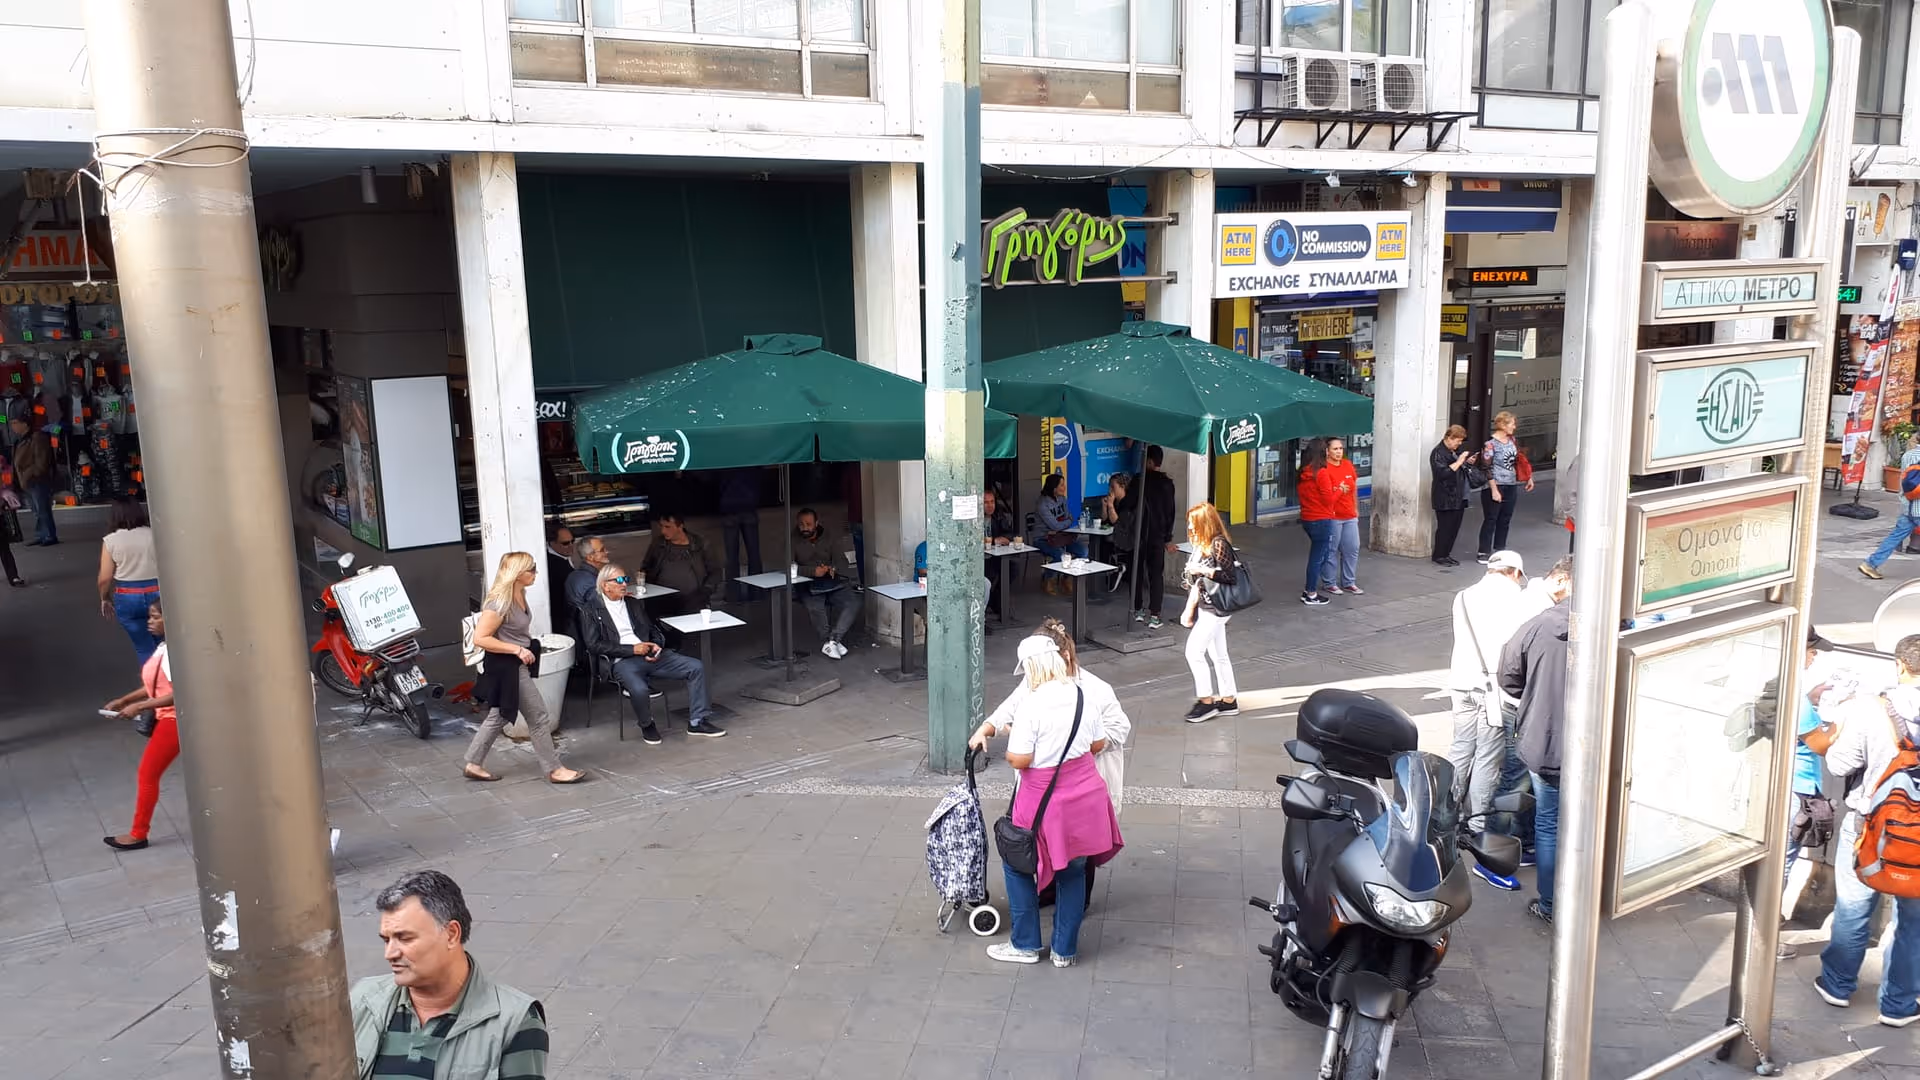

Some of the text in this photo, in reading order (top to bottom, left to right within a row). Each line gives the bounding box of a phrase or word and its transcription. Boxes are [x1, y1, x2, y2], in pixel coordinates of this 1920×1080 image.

[1225, 232, 1252, 244] ATM
[1302, 230, 1319, 242] NO
[1380, 229, 1403, 241] ATM
[1225, 247, 1251, 257] HERE
[1301, 240, 1367, 255] COMMISSION
[1380, 243, 1402, 253] HERE
[1229, 269, 1398, 292] EXCHANGE ΣΥΝΑΛΛΑΓΜΑ
[1473, 271, 1529, 282] ΕΝΕΧΥΡΑ
[1675, 276, 1801, 305] ΑΤΤΙΚΟ ΜΕΤΡΟ
[1708, 378, 1753, 433] ΗΣΑΠ
[1678, 520, 1763, 556] Ομόνοια
[1691, 555, 1744, 577] Omoni
